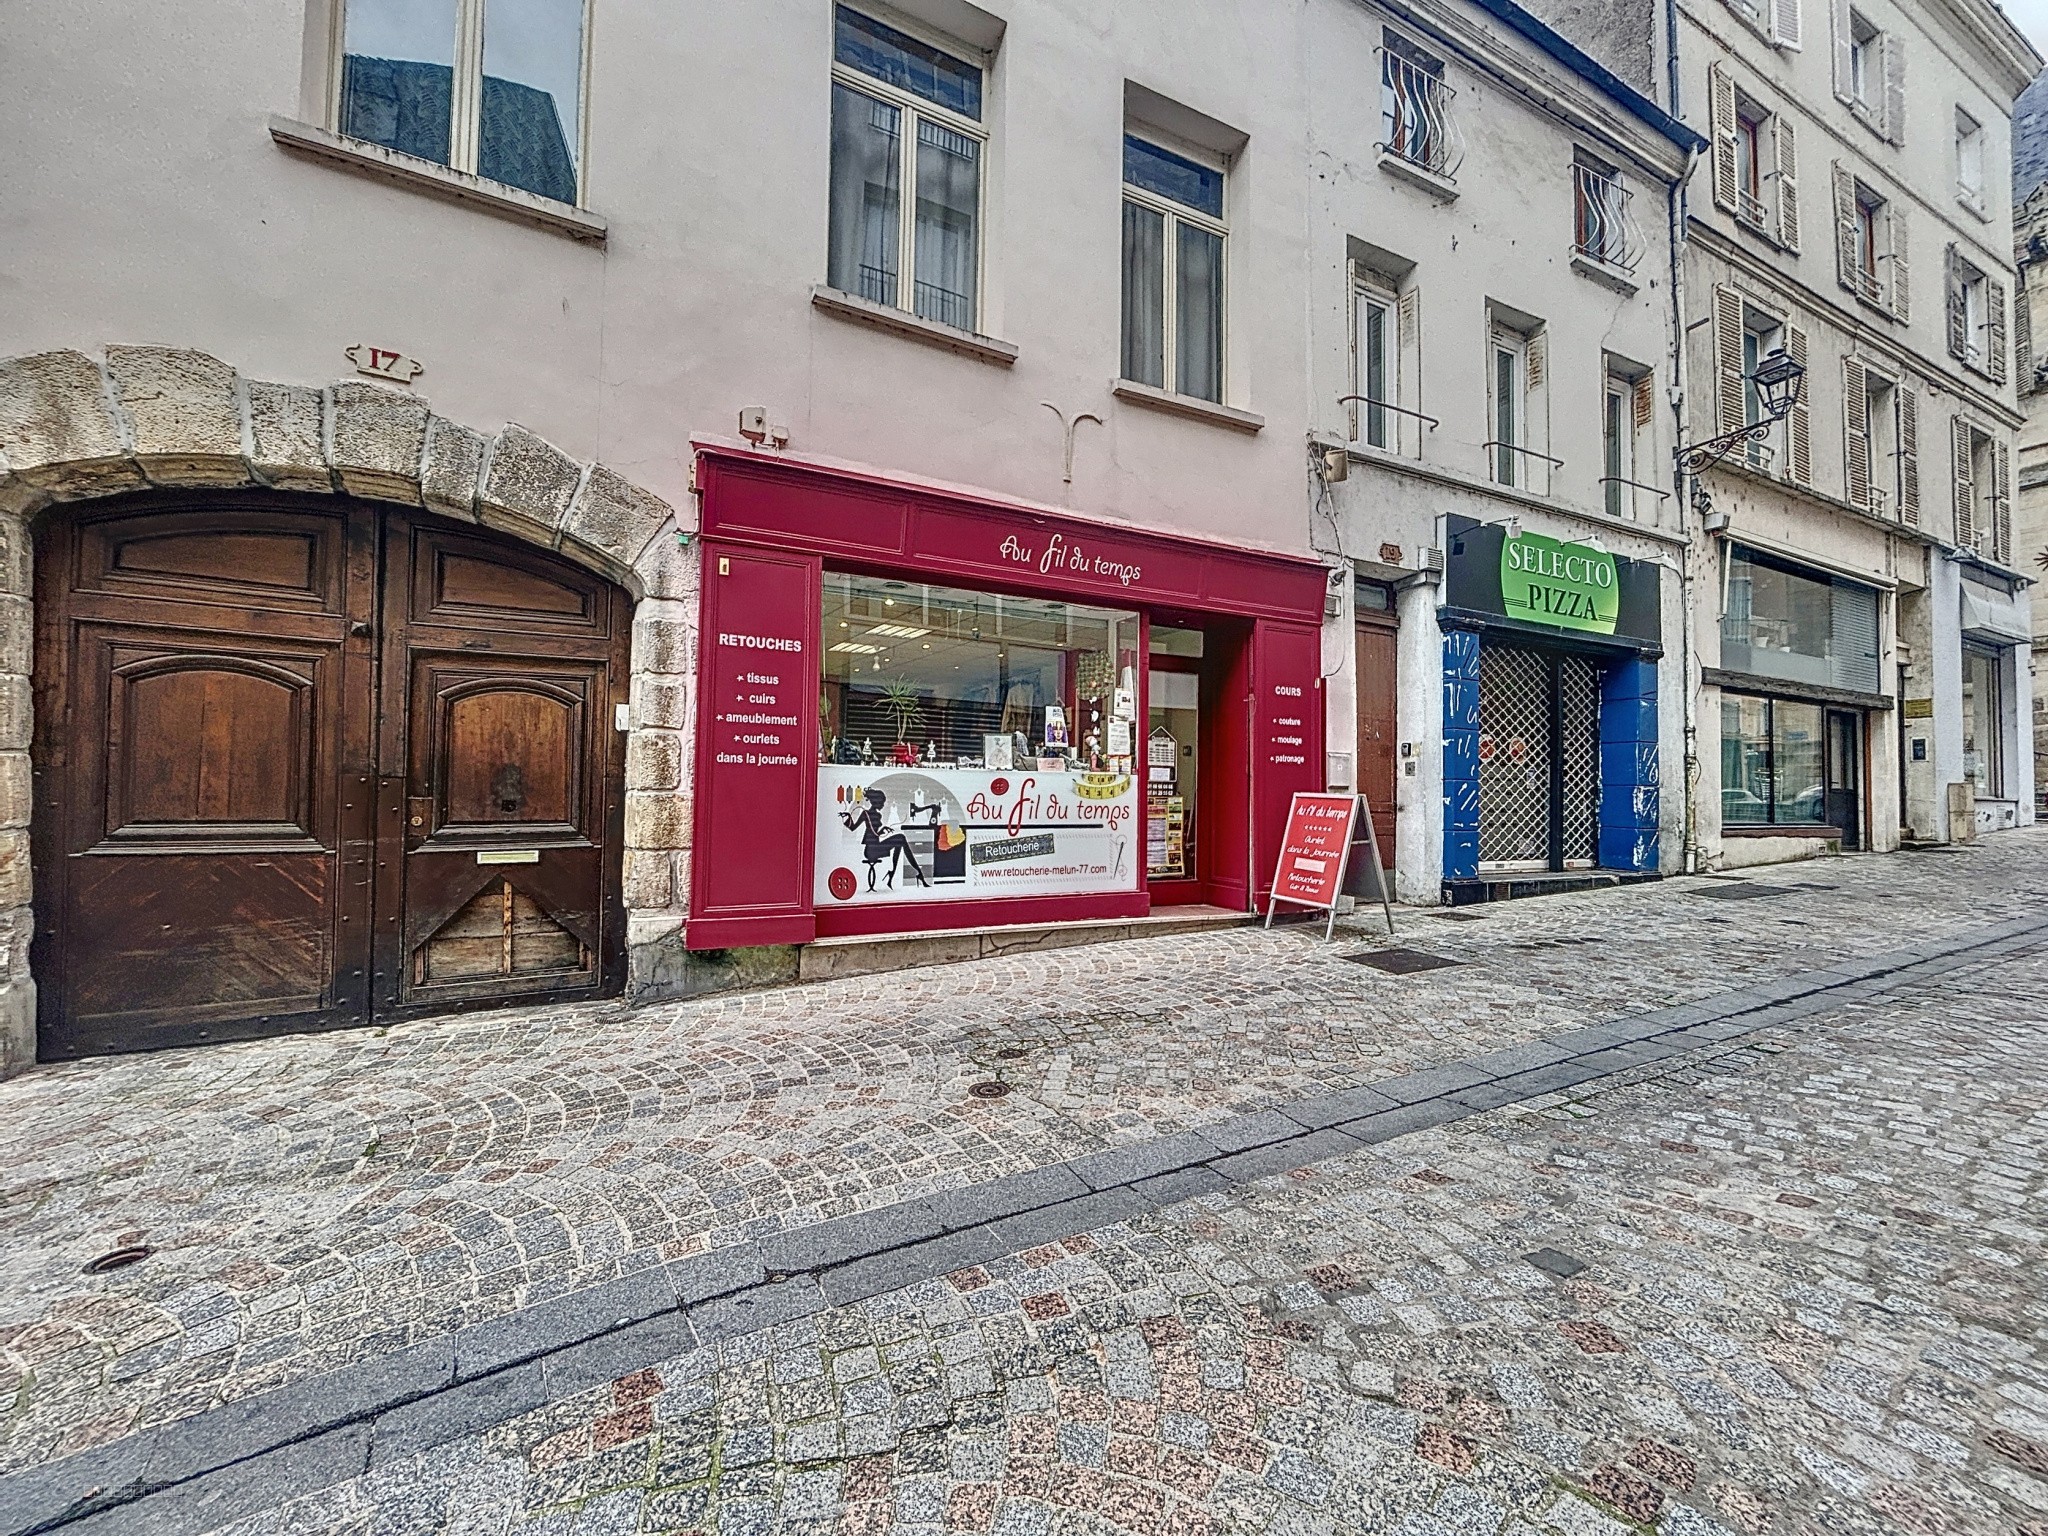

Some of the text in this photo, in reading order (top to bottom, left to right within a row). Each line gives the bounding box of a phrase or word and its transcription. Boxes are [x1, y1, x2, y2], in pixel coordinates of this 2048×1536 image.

[369, 347, 401, 372] 17
[999, 533, 1141, 586] Au fil du temps
[1508, 542, 1612, 588] SELECTO
[1527, 583, 1598, 621] PIZZA
[719, 633, 802, 652] RETOUCHES
[746, 672, 779, 685] tissus
[1275, 685, 1301, 697] COURS
[749, 693, 776, 705] cuirs
[725, 713, 797, 726] ameublement
[1278, 717, 1301, 726] couture
[742, 733, 780, 745] ourlets
[1277, 736, 1302, 746] moulage
[716, 752, 798, 766] dans la journée
[1275, 754, 1305, 765] patronage
[966, 778, 1130, 837] Au fil du temps
[985, 841, 1040, 858] Retoucherie
[980, 864, 1107, 878] www.retoucherie-melun-77.com
